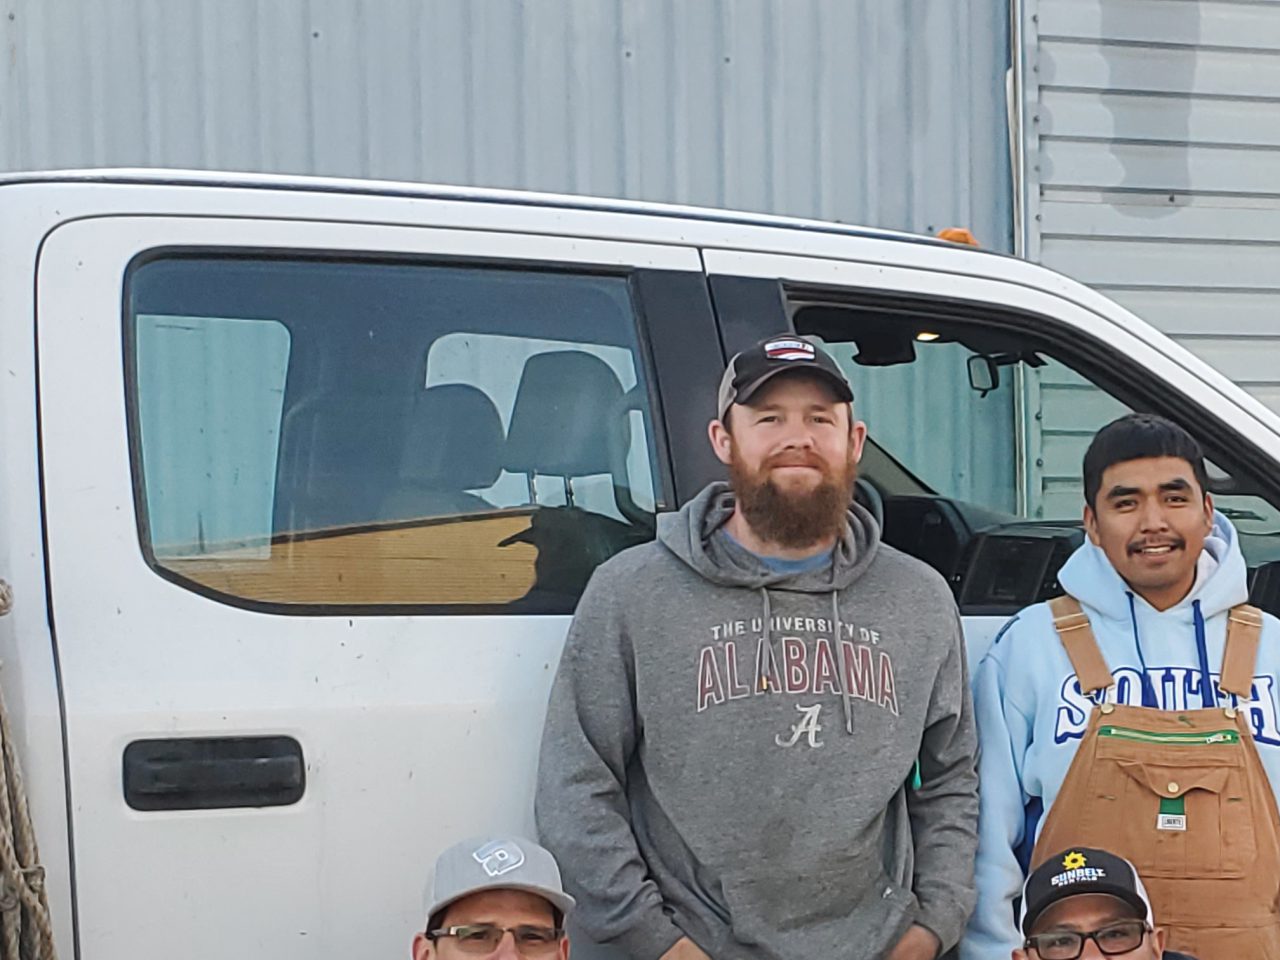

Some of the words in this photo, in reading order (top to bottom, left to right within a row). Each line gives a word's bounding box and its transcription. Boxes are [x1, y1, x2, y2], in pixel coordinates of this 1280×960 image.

[711, 620, 746, 641] THE
[752, 616, 854, 638] UIVERSIY
[859, 626, 880, 645] OF
[697, 636, 899, 716] ALABAMA
[775, 703, 824, 748] A
[1051, 867, 1106, 886] SUNBELT
